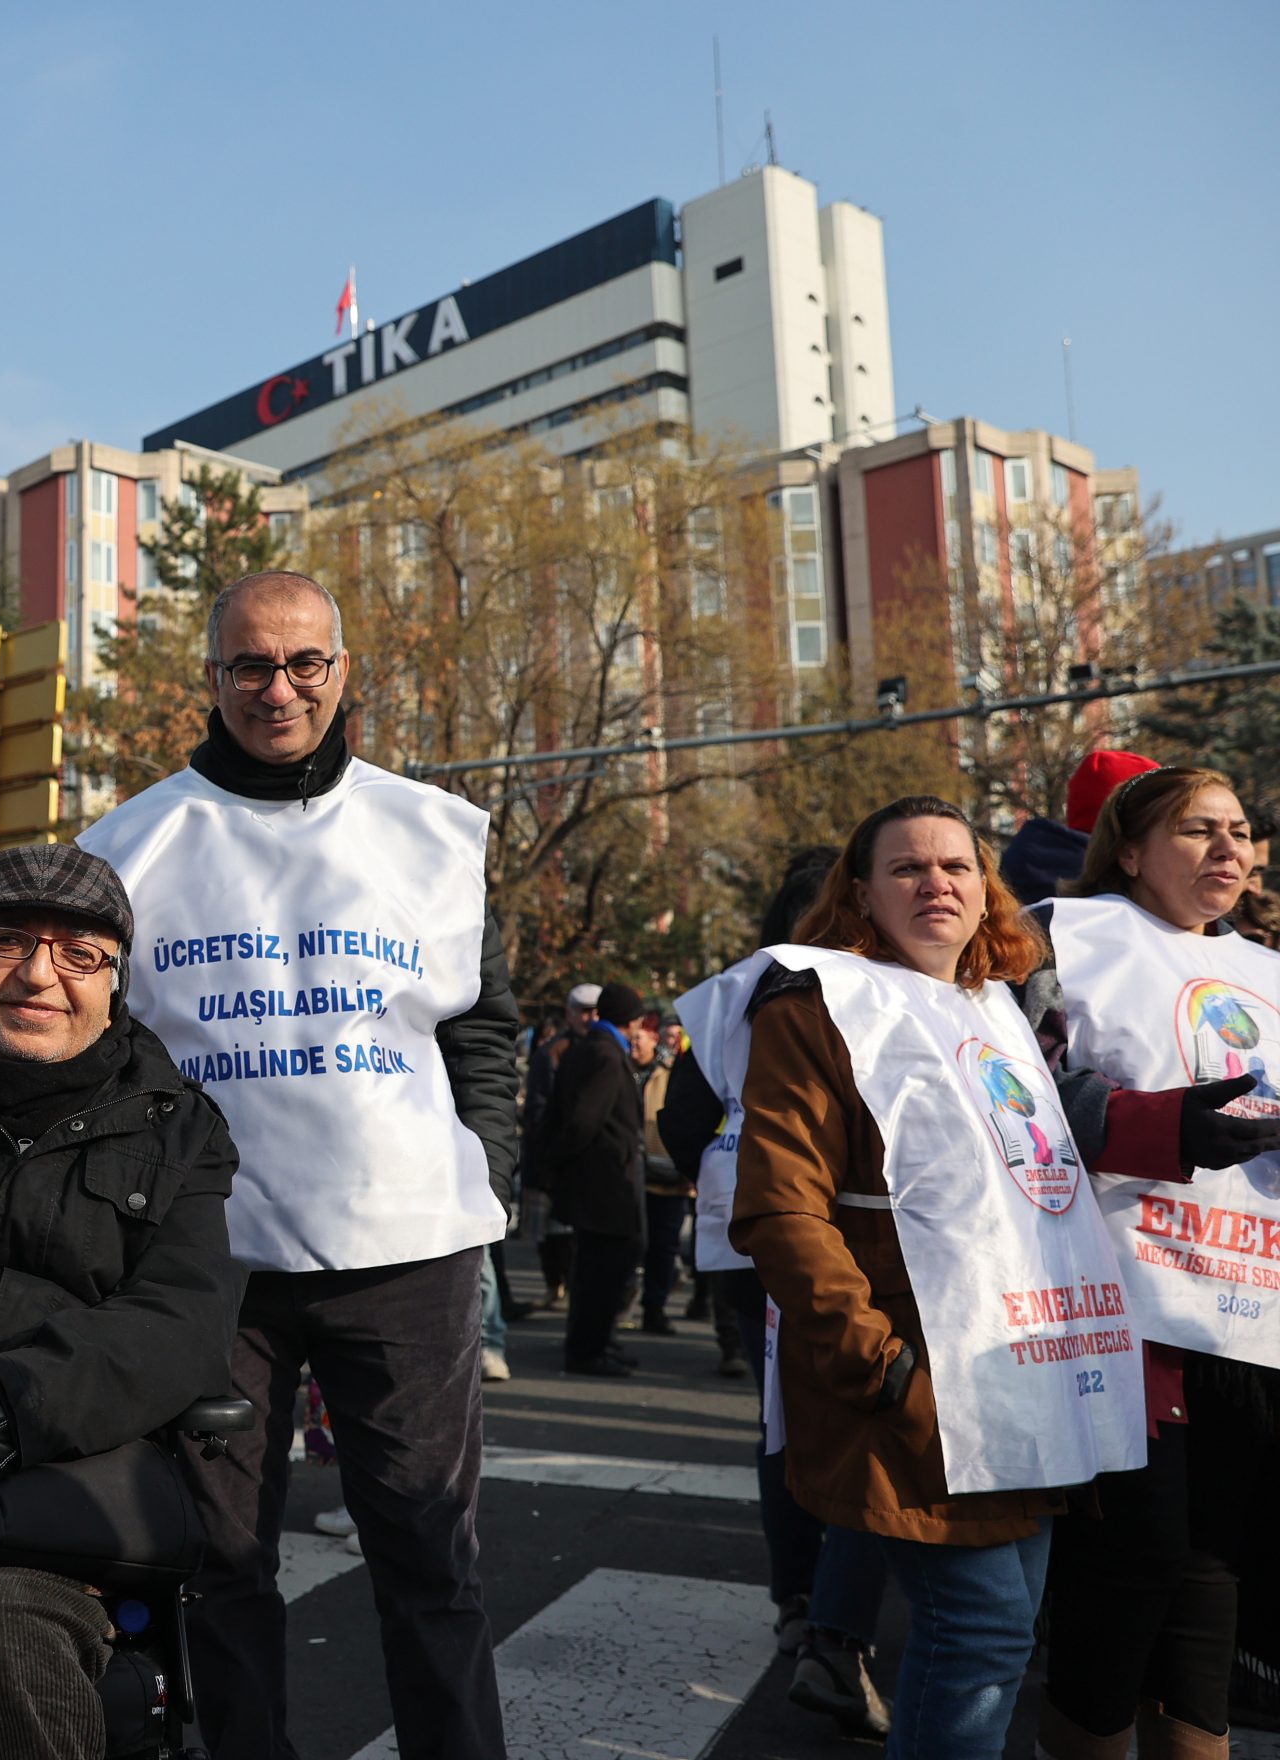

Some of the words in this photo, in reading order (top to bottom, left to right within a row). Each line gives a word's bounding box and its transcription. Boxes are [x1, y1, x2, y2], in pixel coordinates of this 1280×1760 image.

[322, 295, 470, 397] TİKA
[154, 927, 289, 972] ÜCRETSİZ,
[298, 922, 424, 979] NİTELİKLİ,
[198, 980, 388, 1025] ULAŞILABİLİR,
[335, 1037, 415, 1075] SAĞLIK
[1136, 1193, 1280, 1262] EMEK
[1136, 1241, 1248, 1284] MECLİSLERİ
[1217, 1293, 1261, 1320] 2023
